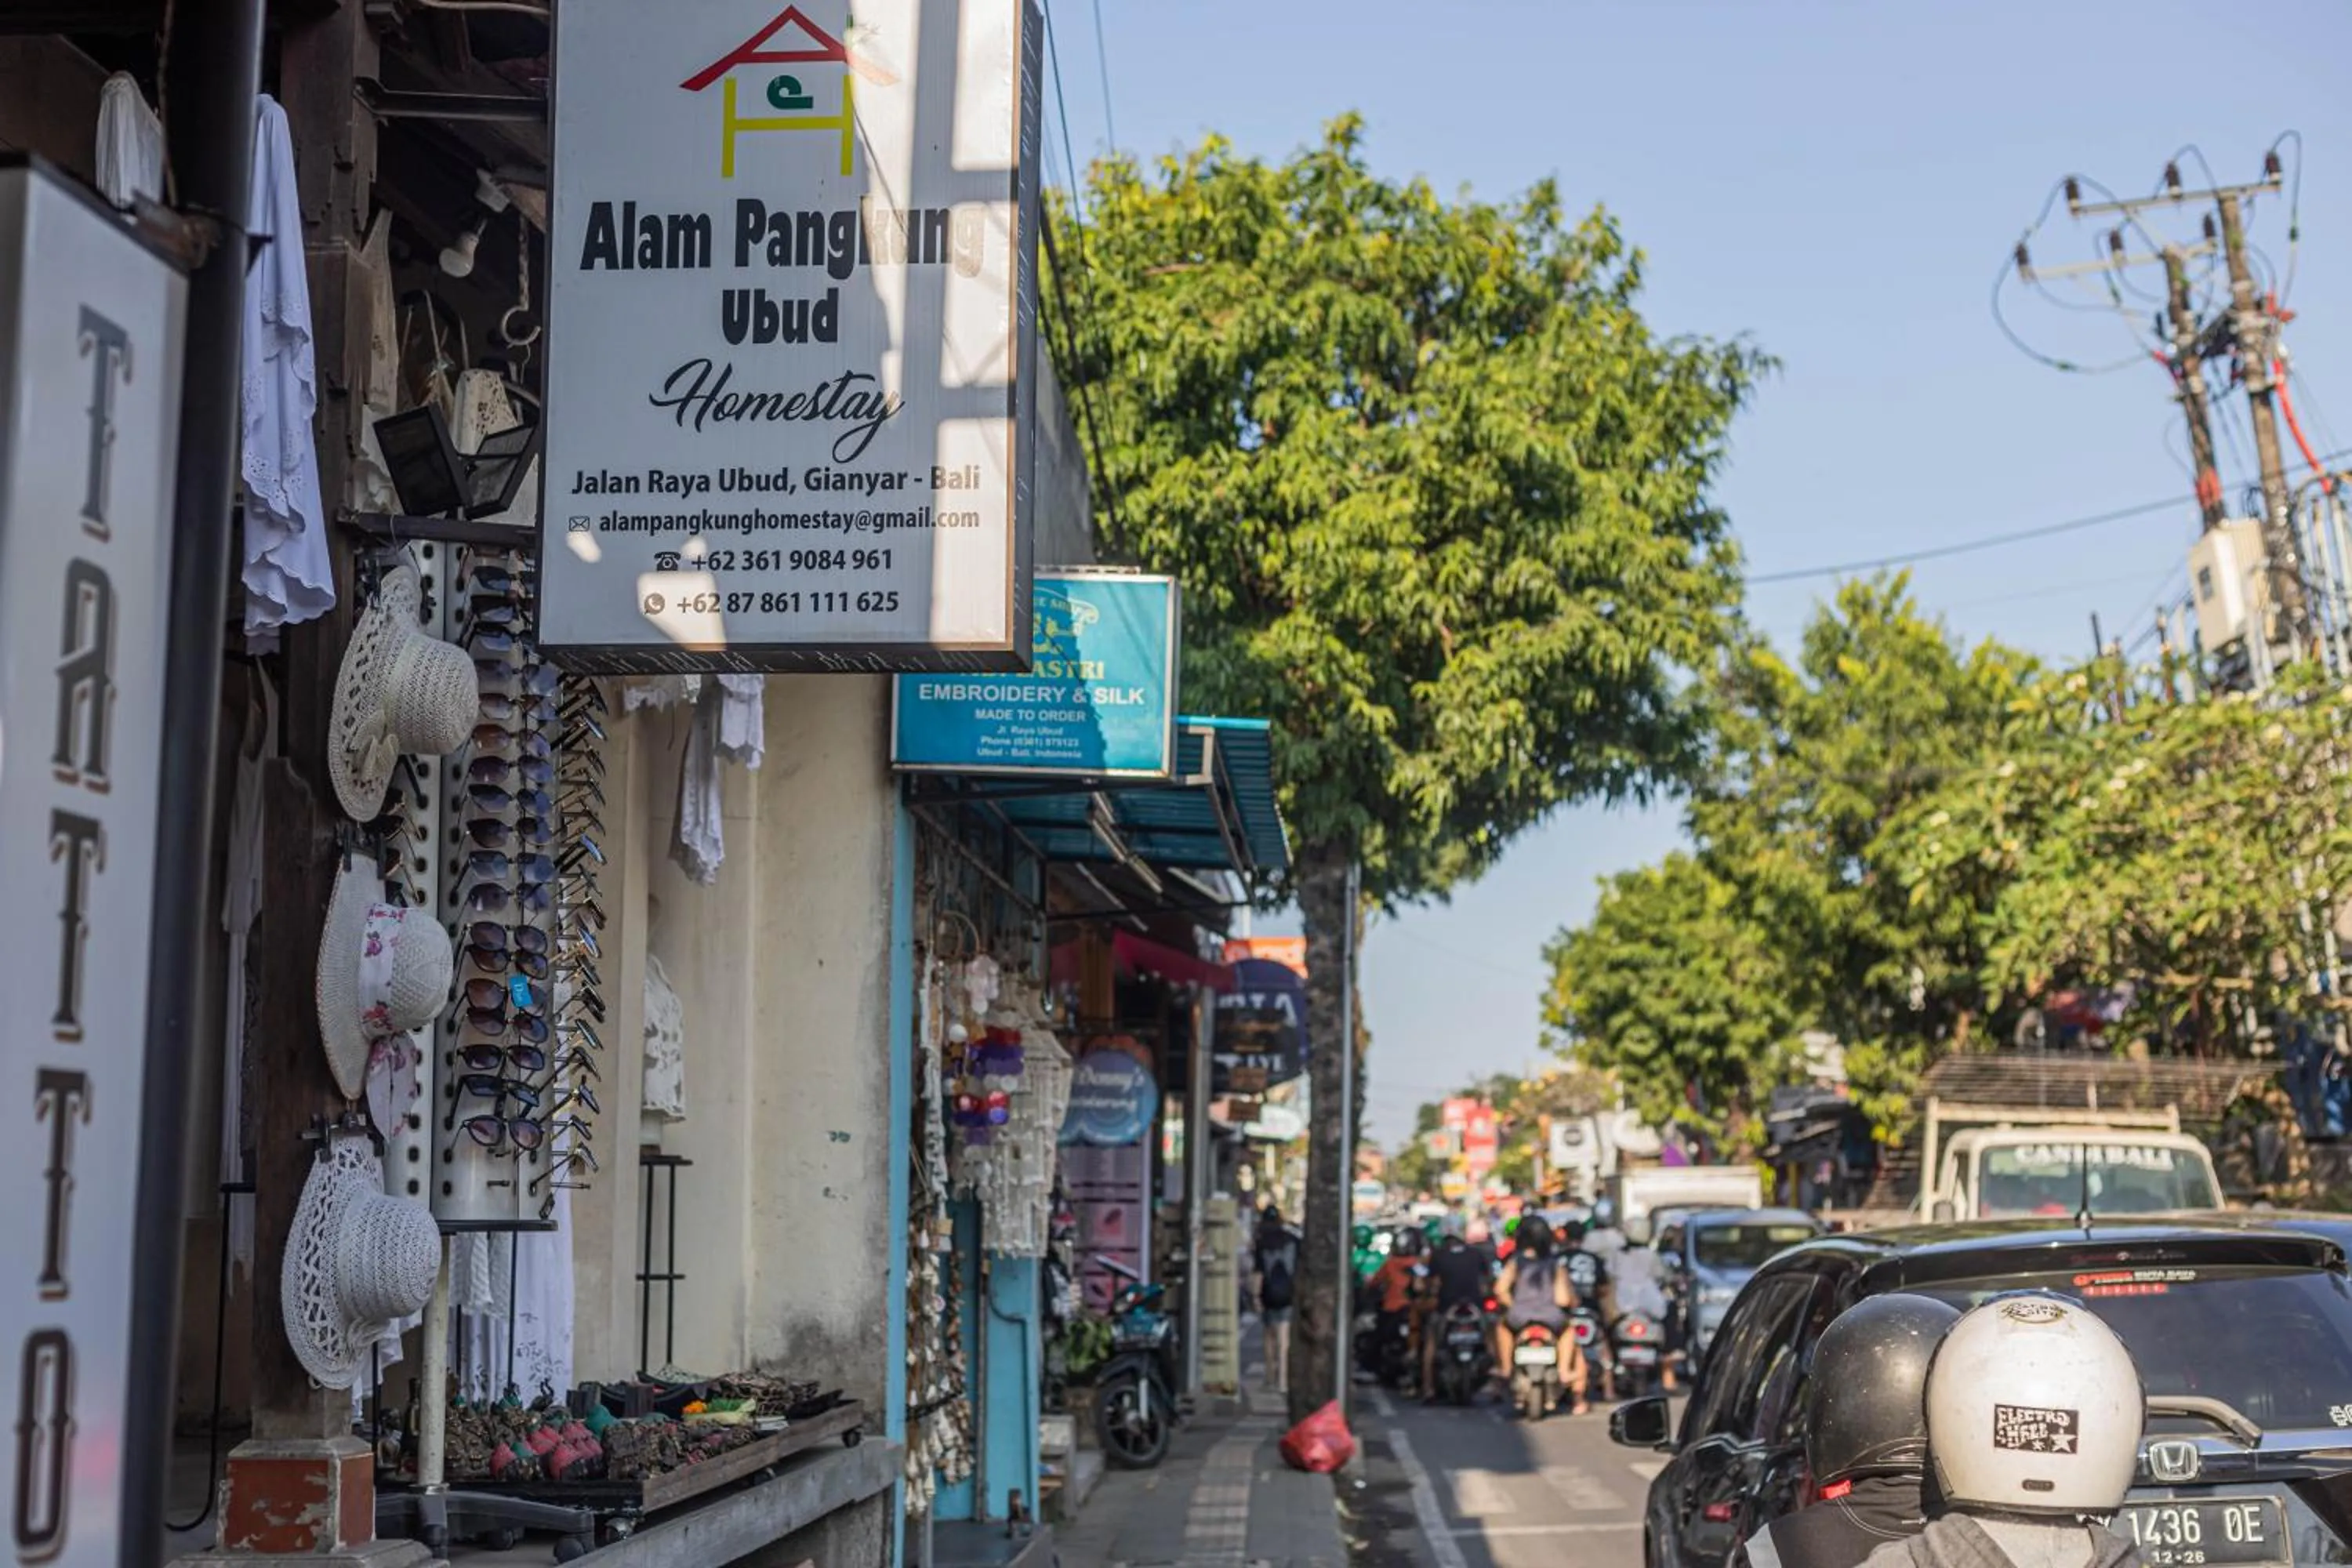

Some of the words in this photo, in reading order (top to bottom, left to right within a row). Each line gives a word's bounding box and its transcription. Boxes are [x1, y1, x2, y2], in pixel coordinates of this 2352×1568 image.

[580, 200, 712, 270] Alam
[735, 196, 985, 280] Pangkung
[721, 288, 839, 345] Ubud
[648, 358, 906, 463] Homestay
[572, 470, 640, 496] Jalan
[648, 470, 710, 498] Raya
[718, 467, 797, 496] Ubud,
[804, 467, 908, 498] Gianyar
[931, 466, 980, 491] Bali
[599, 506, 980, 537] alampangkunghomestay@gmail.com
[691, 550, 735, 572] +62
[741, 550, 782, 572] 361
[790, 550, 847, 572] 9084
[851, 549, 893, 571] 961
[677, 592, 720, 615] +62
[727, 592, 755, 613] 87
[760, 592, 800, 613] 861
[805, 592, 851, 612] 111
[856, 590, 899, 613] 625
[1016, 659, 1105, 680] ASTRI
[919, 683, 1064, 703] EMBROIDERY
[1072, 688, 1087, 703] &
[1094, 687, 1145, 705] SILK
[975, 708, 1014, 720] MADE
[1018, 710, 1035, 720] TO
[1038, 710, 1086, 722] ORDER
[2128, 1508, 2201, 1547] 1436
